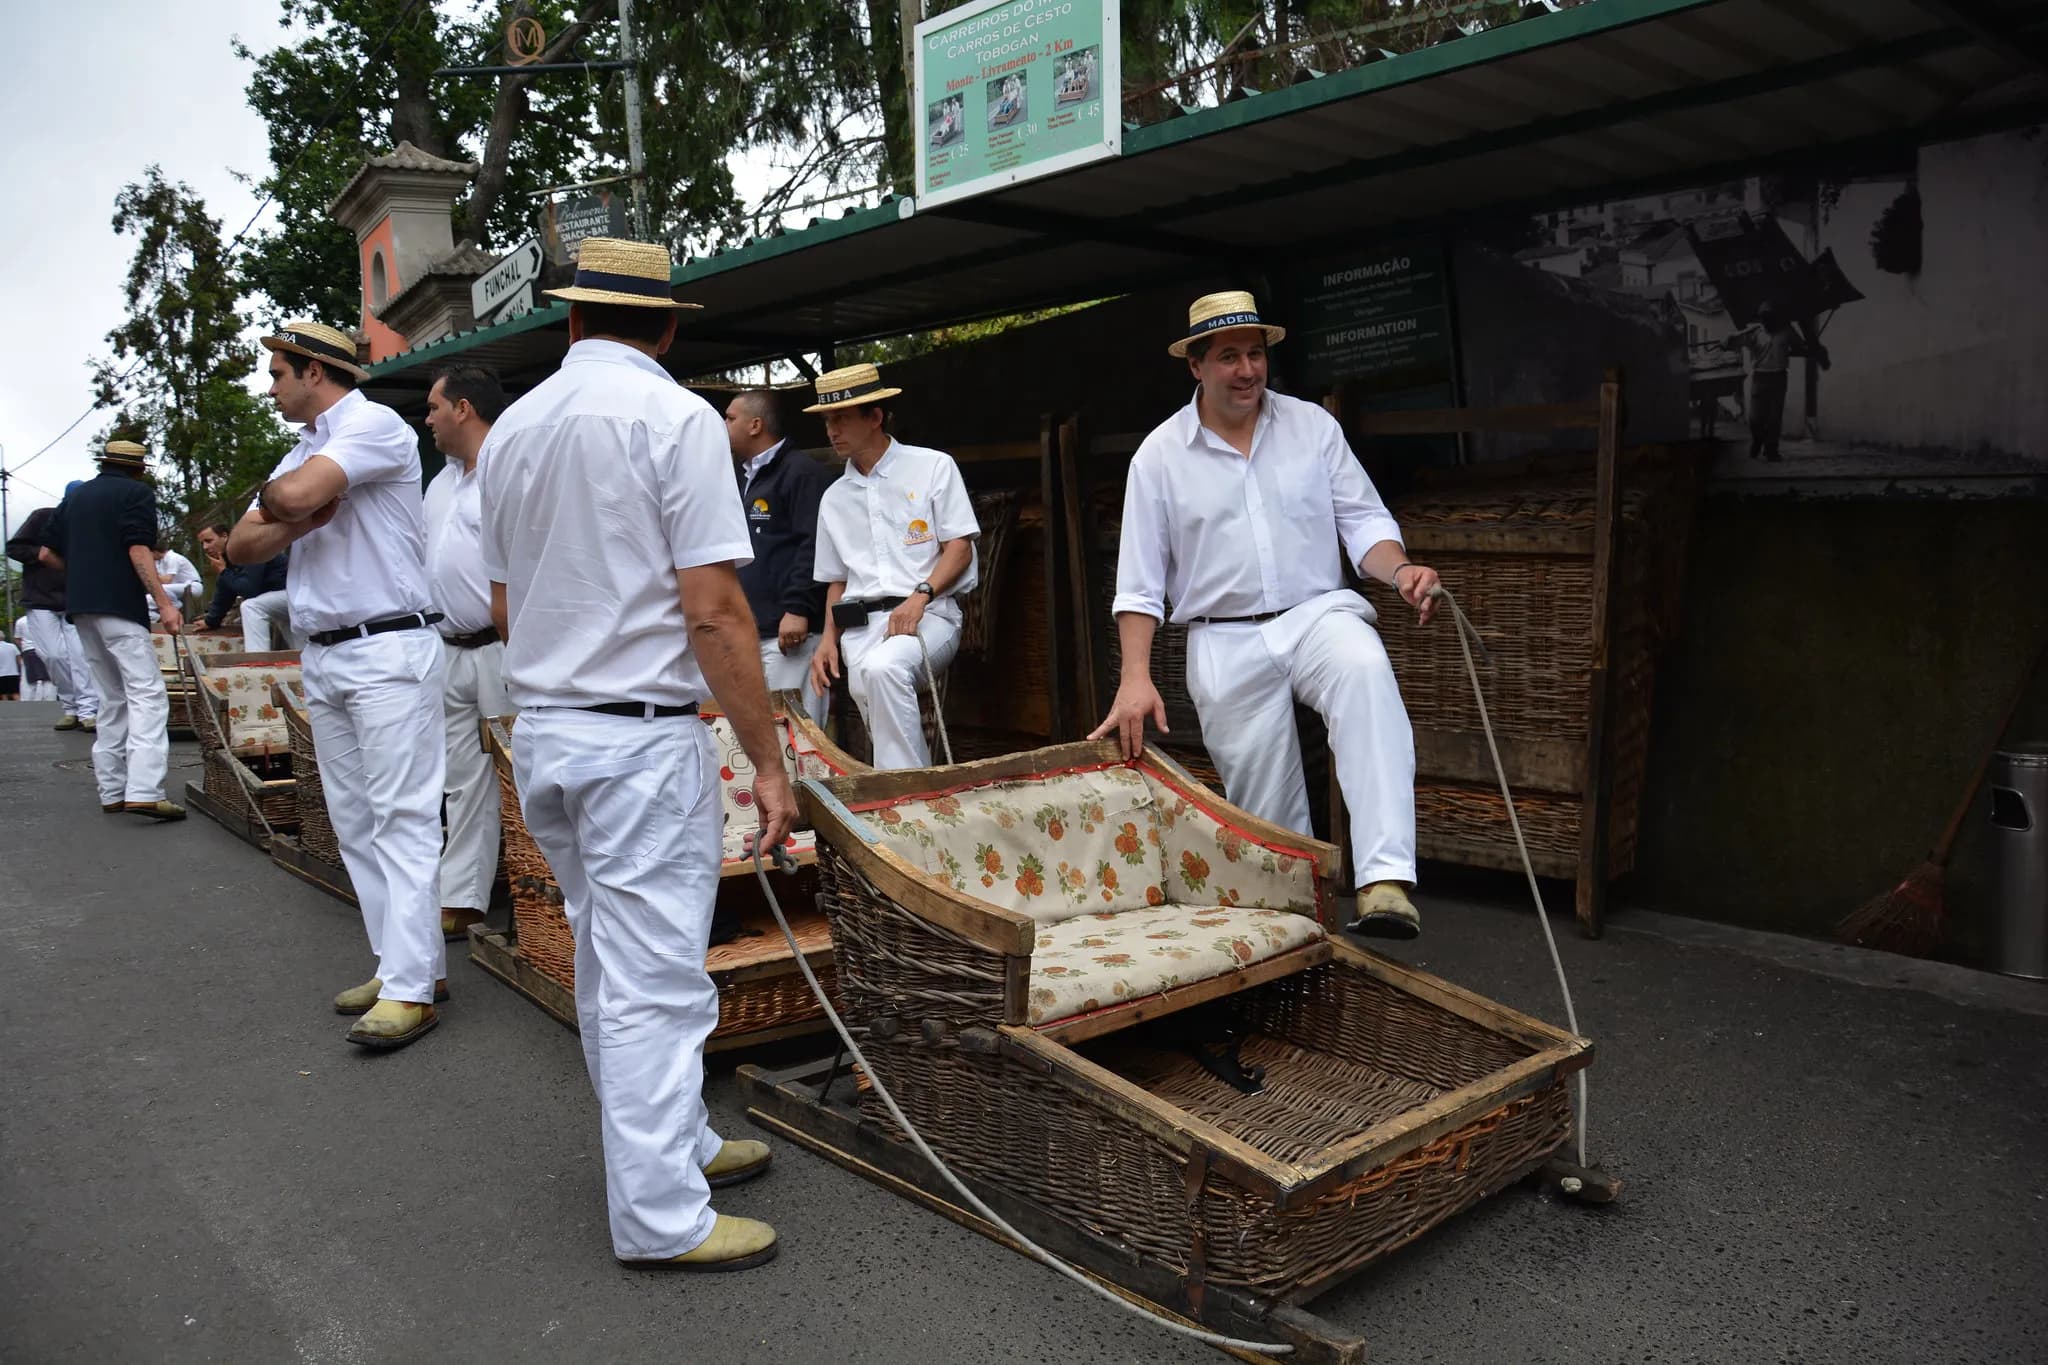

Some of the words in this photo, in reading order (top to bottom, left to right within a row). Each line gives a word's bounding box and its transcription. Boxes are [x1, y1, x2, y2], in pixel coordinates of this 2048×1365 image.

[929, 10, 1009, 50] CARREIROS
[1013, 2, 1033, 17] DO
[947, 32, 1000, 60] CARROS
[1003, 20, 1021, 37] DE
[1024, 3, 1072, 28] CESTO
[975, 32, 1039, 65] TOBOGAN
[1045, 43, 1051, 57] 2
[554, 214, 611, 233] RESTAURANTE
[484, 259, 522, 302] FUNCHAL
[1323, 257, 1411, 287] INFORMAÇÃO
[1208, 314, 1260, 329] MADEIRA
[1326, 318, 1417, 346] INFORMATION
[817, 389, 853, 404] EIRA
